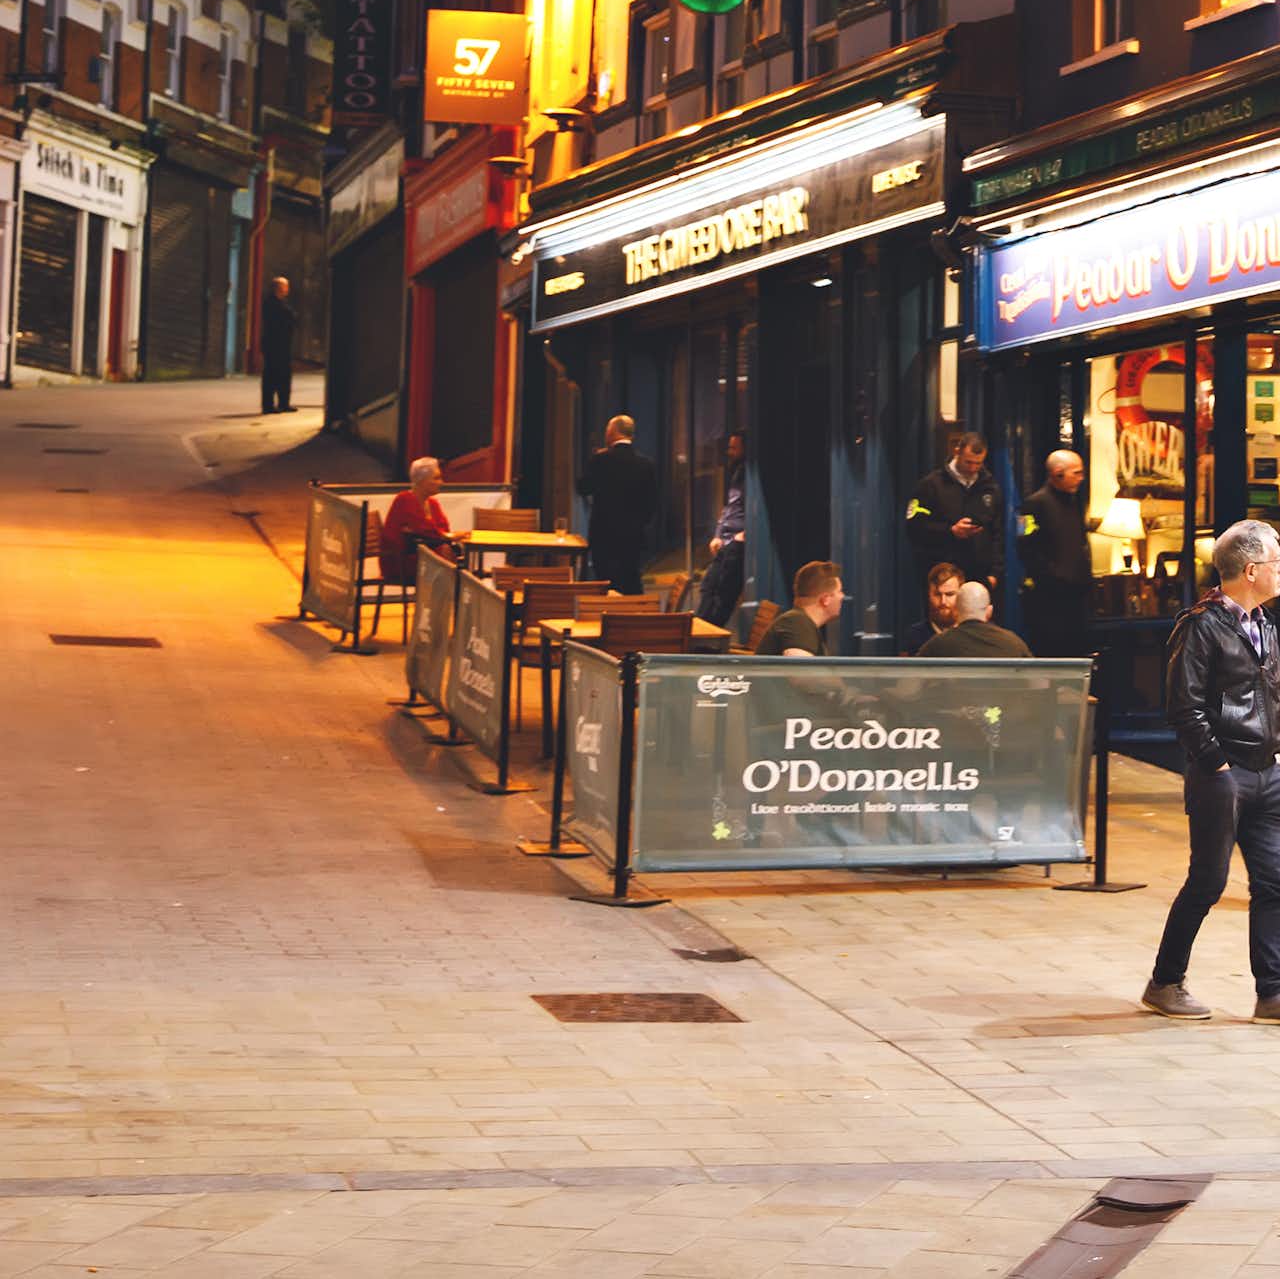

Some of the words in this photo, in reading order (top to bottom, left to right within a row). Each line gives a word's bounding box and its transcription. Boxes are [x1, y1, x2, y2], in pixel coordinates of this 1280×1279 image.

[344, 0, 377, 108] TATTOO
[454, 38, 501, 75] 57
[436, 76, 472, 88] FIFTY
[475, 78, 515, 91] SEVEN
[37, 142, 74, 180] Stitch
[621, 234, 661, 285] THE
[761, 186, 811, 240] BAR
[697, 674, 753, 698] Carlsberg
[784, 717, 941, 751] Peadar
[742, 758, 980, 793] O'Donnells
[751, 803, 779, 814] Live
